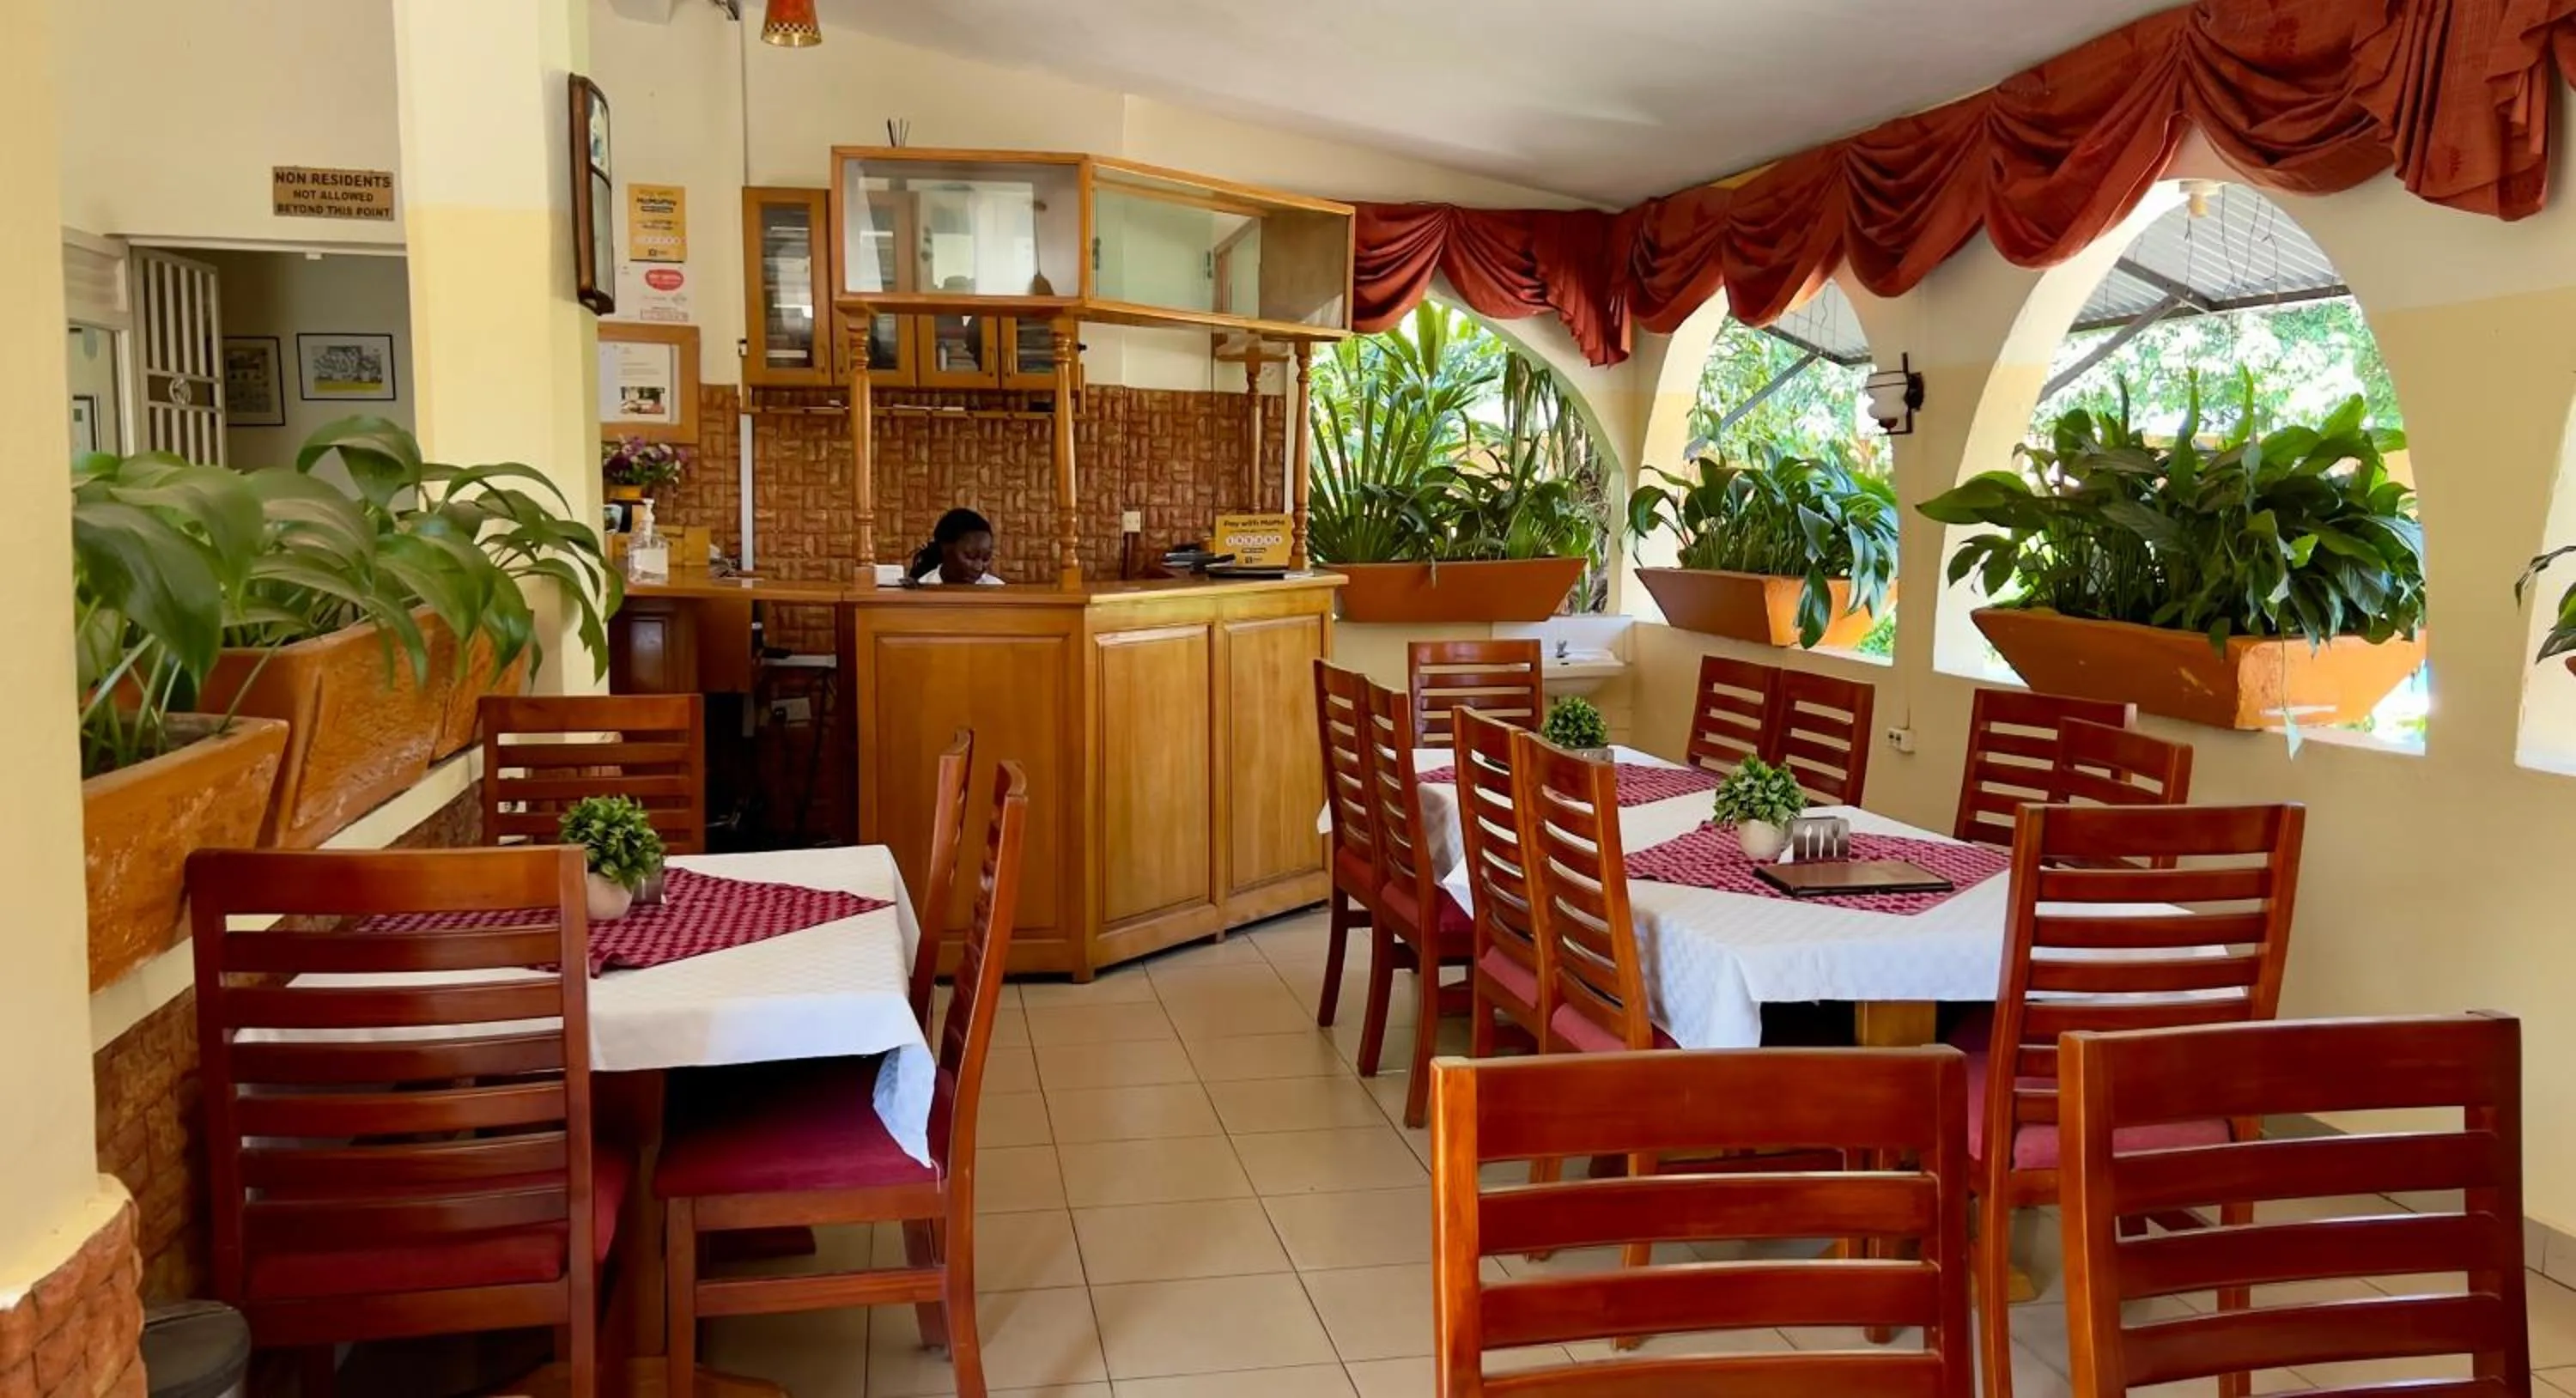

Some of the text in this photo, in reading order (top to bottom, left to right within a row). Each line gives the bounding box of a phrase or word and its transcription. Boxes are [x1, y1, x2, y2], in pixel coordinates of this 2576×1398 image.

[275, 172, 392, 188] NON RESIDENTS
[293, 189, 374, 203] NOT ALLOWED
[276, 204, 391, 217] BEYOND THIS POINT
